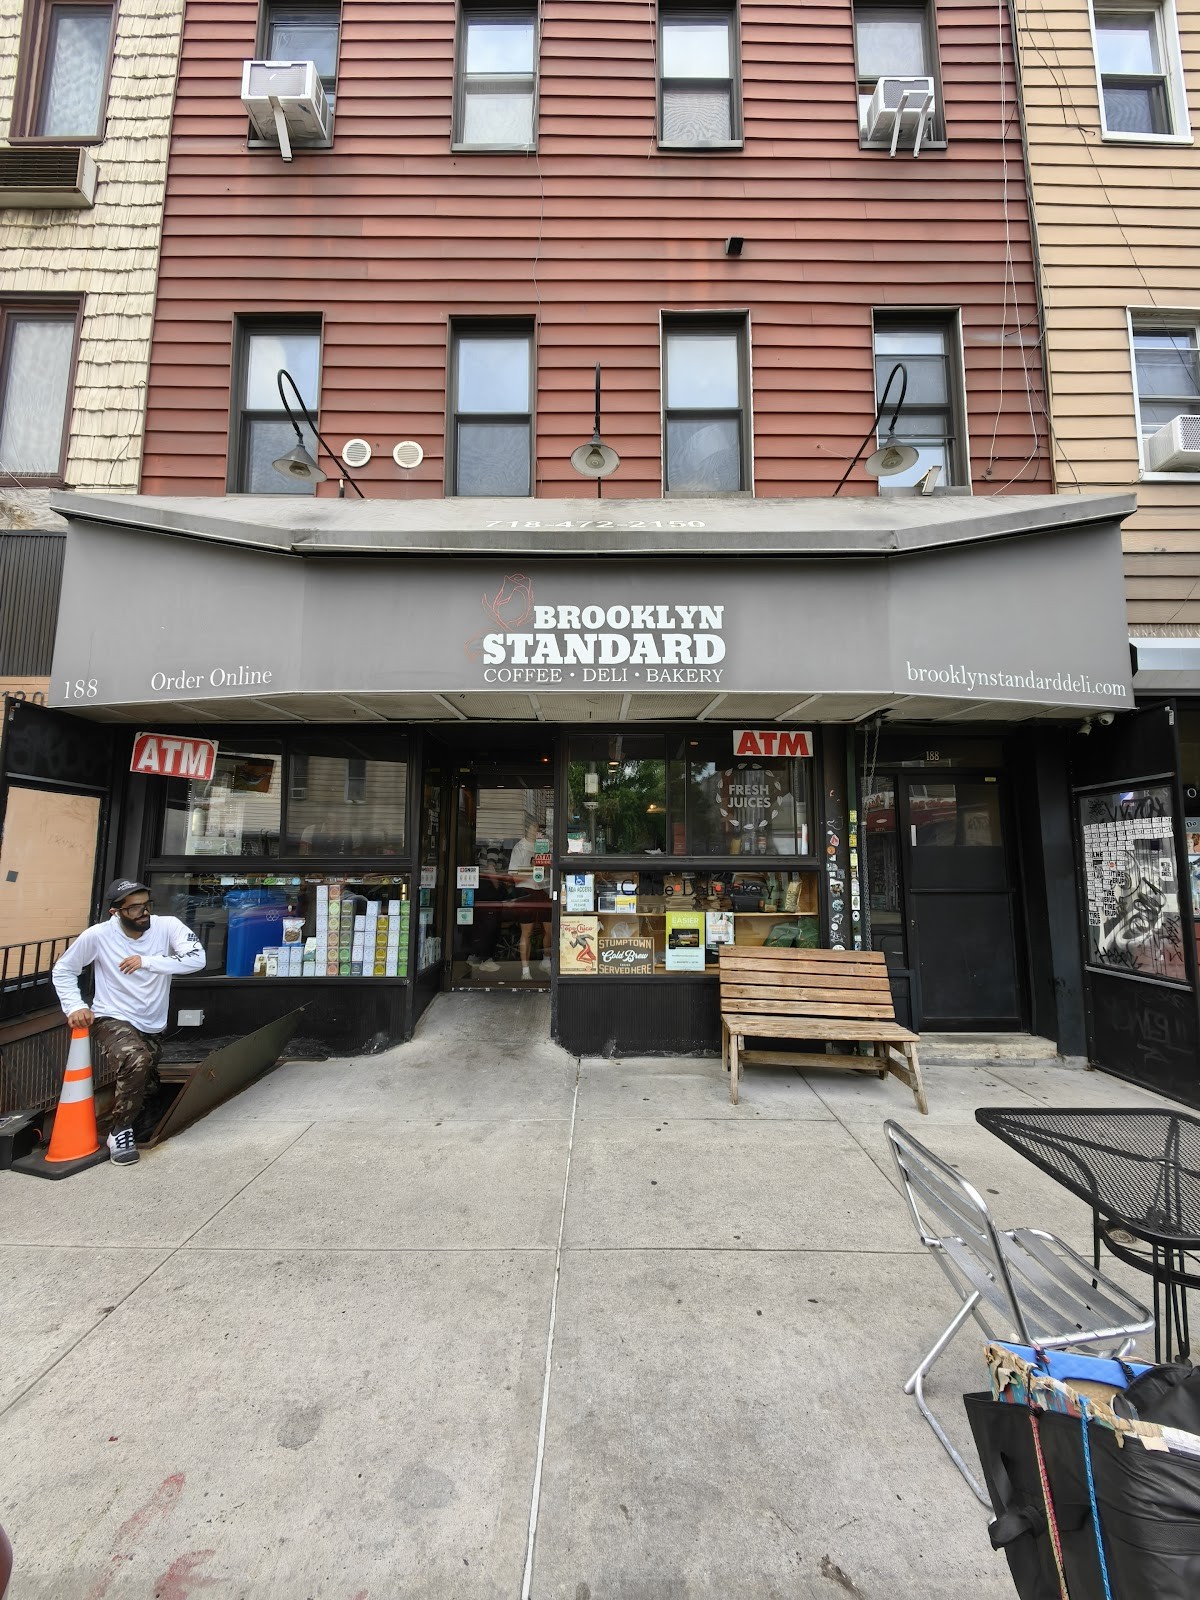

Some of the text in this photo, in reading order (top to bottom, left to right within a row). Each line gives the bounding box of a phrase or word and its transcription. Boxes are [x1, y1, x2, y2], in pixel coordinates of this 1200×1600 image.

[485, 520, 706, 529] 718-472-2150
[533, 605, 725, 629] BROOKLYN
[482, 633, 727, 665] STANDARD
[150, 665, 273, 691] Order Online
[483, 668, 725, 683] COFFEE DELI BAKERY
[905, 661, 1127, 696] brooklynstandarddeli.com
[63, 679, 99, 700] 188
[736, 731, 810, 756] ATM
[137, 737, 209, 777] ATM
[925, 750, 940, 762] 188
[728, 784, 770, 796] FRESH
[727, 796, 772, 809] JUICES
[671, 917, 700, 925] EASIER
[576, 923, 594, 934] Chico
[598, 939, 652, 950] STUMPTOWN
[601, 949, 649, 963] Cold Brew
[598, 963, 630, 975] SERVED
[630, 963, 652, 975] HERE
